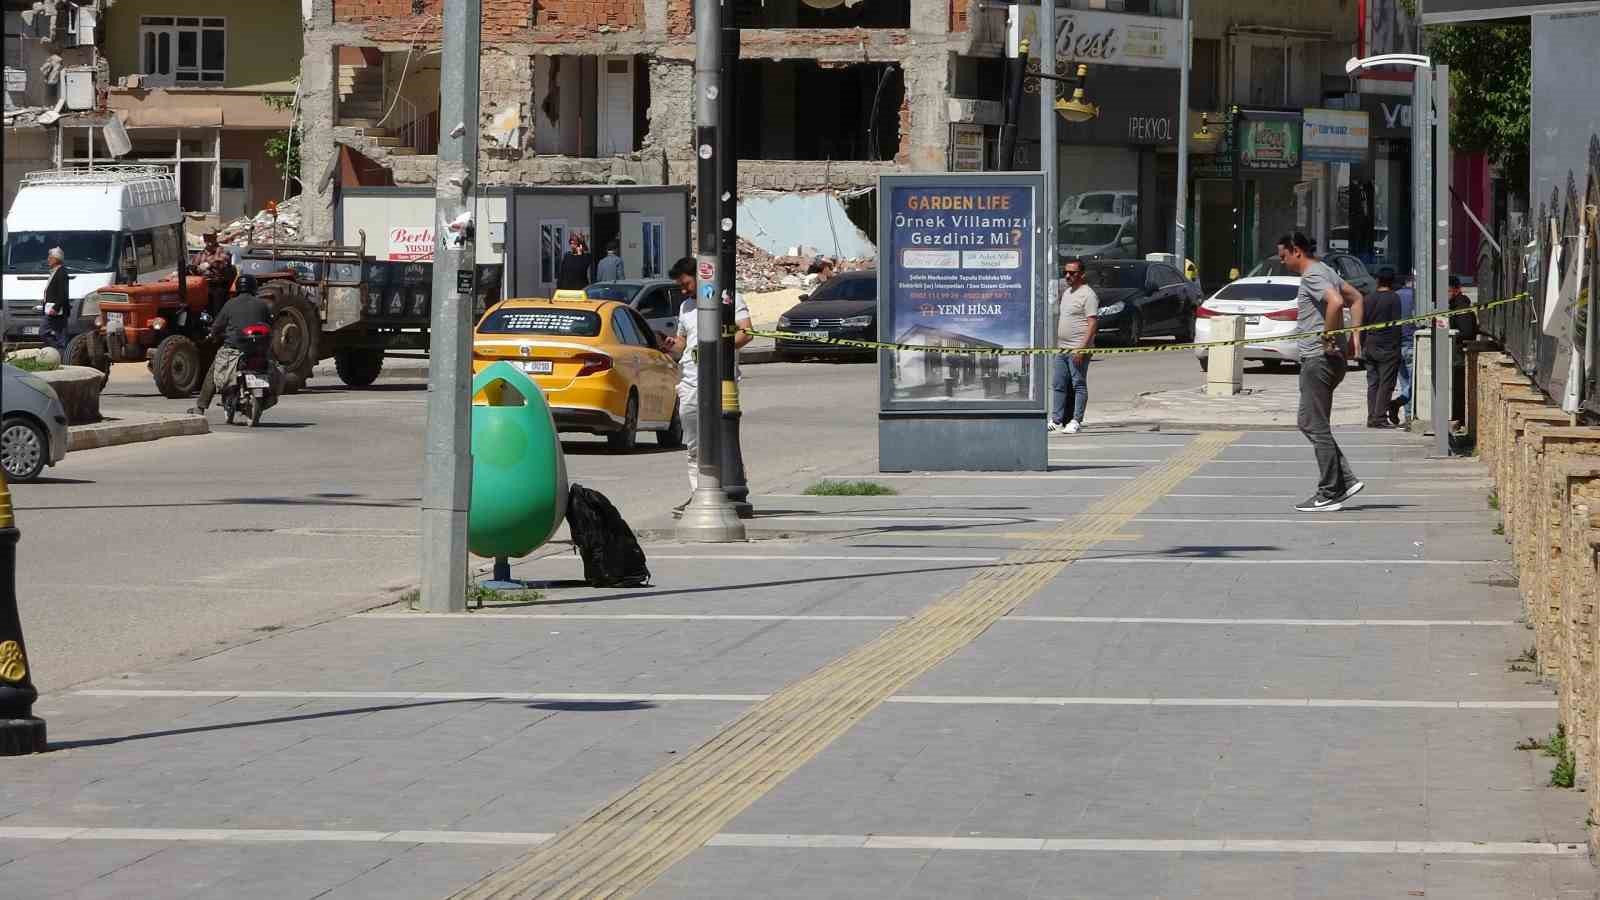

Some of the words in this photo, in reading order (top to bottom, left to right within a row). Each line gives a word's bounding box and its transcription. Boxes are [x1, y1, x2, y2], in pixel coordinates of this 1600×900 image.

[907, 195, 973, 210] GARDEN
[977, 196, 1011, 210] LIFE
[895, 211, 945, 228] Örnek
[951, 214, 1027, 228] Villamızı
[391, 228, 434, 244] Berb
[911, 231, 985, 245] Gezdiniz
[937, 304, 965, 315] YENİ
[968, 303, 1002, 315] HİSAR
